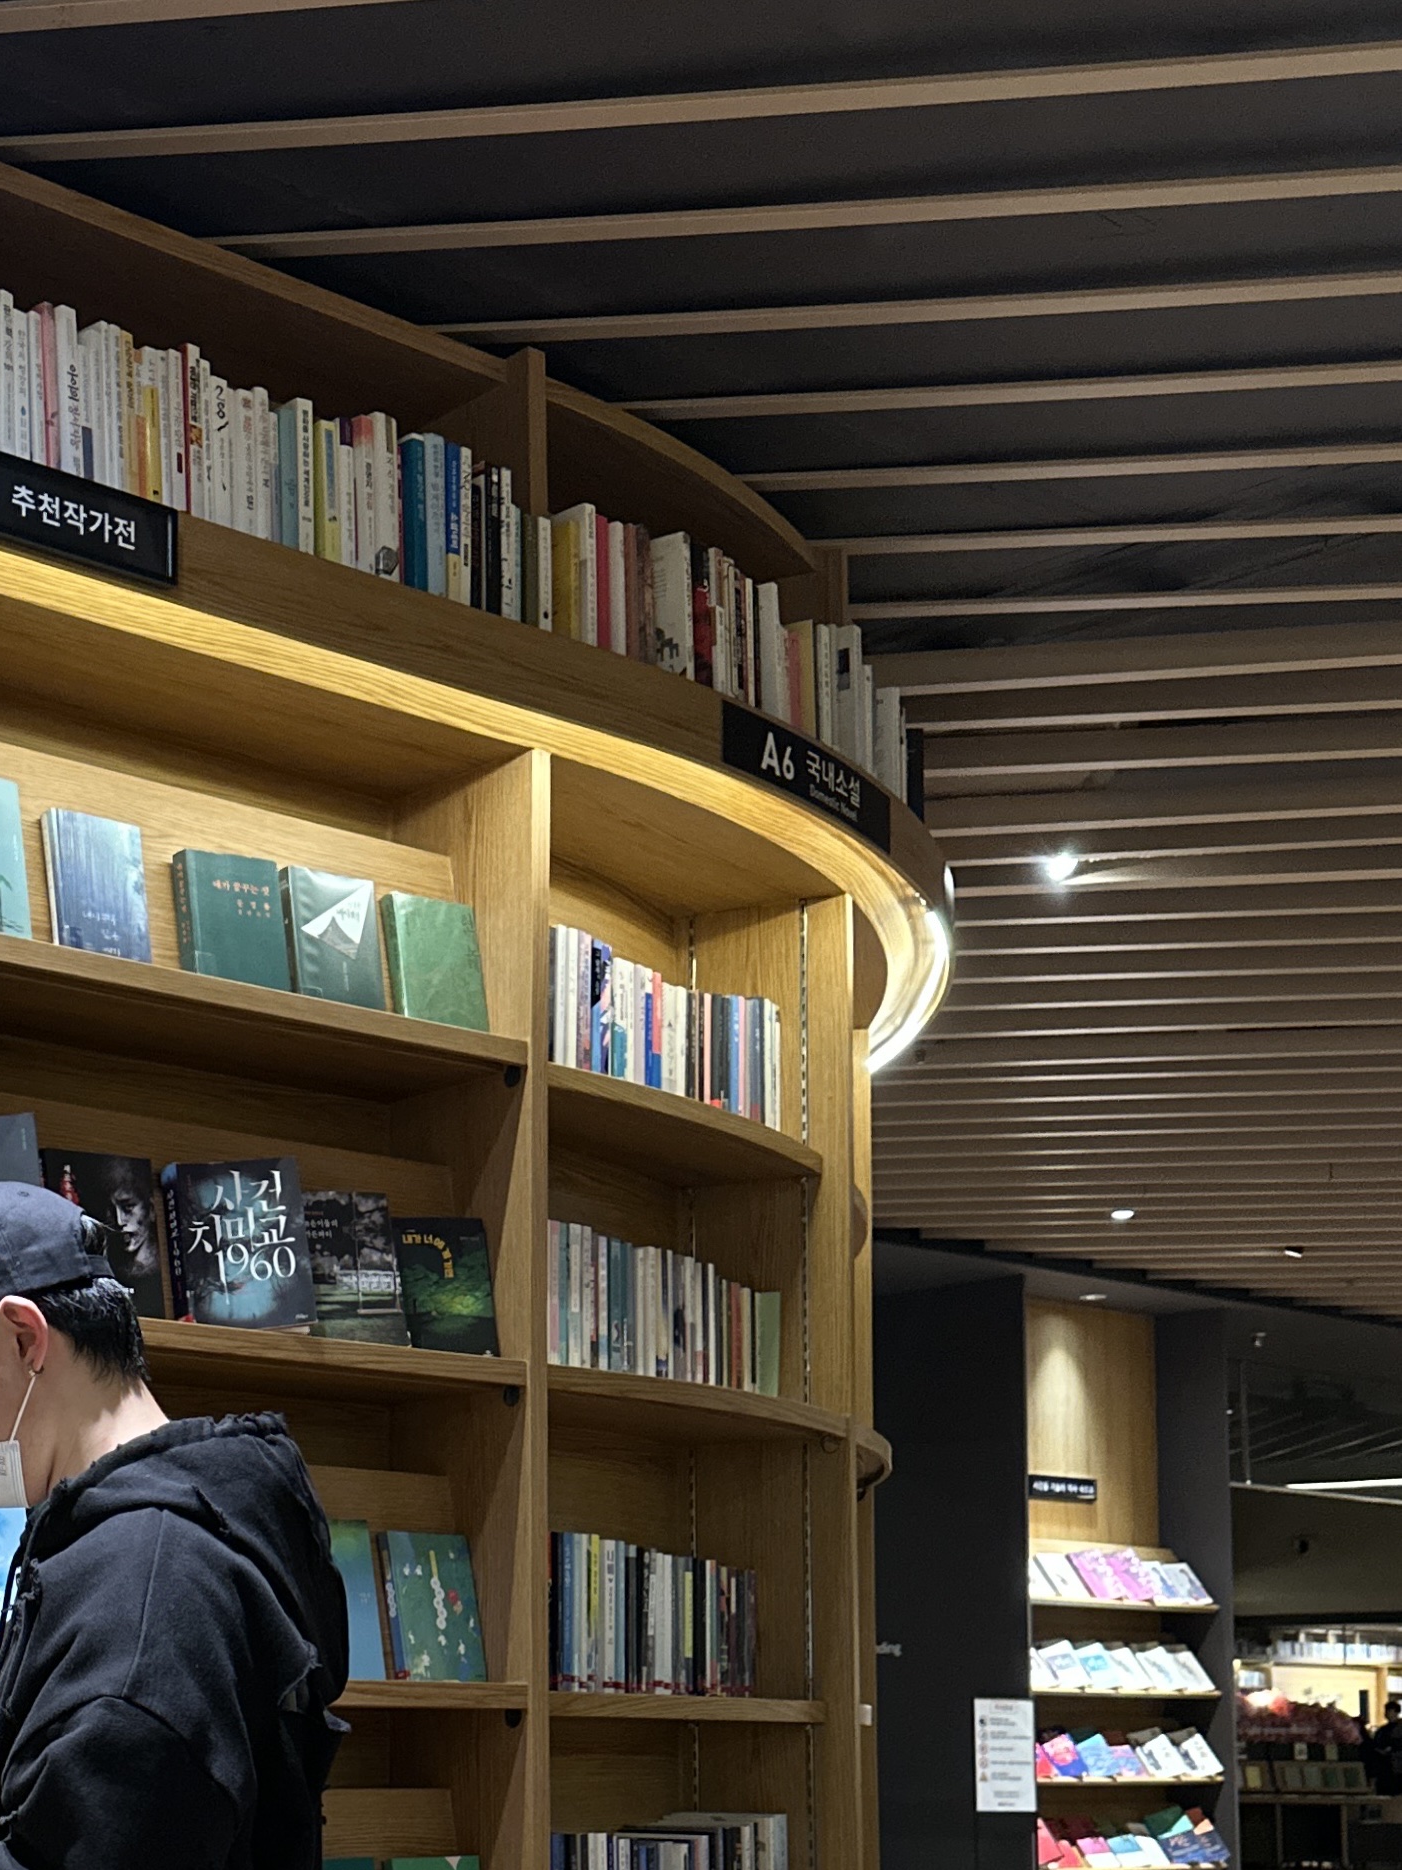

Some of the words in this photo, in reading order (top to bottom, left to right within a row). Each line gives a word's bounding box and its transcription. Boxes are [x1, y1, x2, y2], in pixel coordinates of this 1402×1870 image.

[10, 484, 136, 551] 추천작가전
[760, 731, 795, 781] A6
[805, 750, 861, 809] 국내소설
[211, 1168, 287, 1213] 사건
[186, 1205, 297, 1260] 치미교
[214, 1242, 297, 1306] 1960
